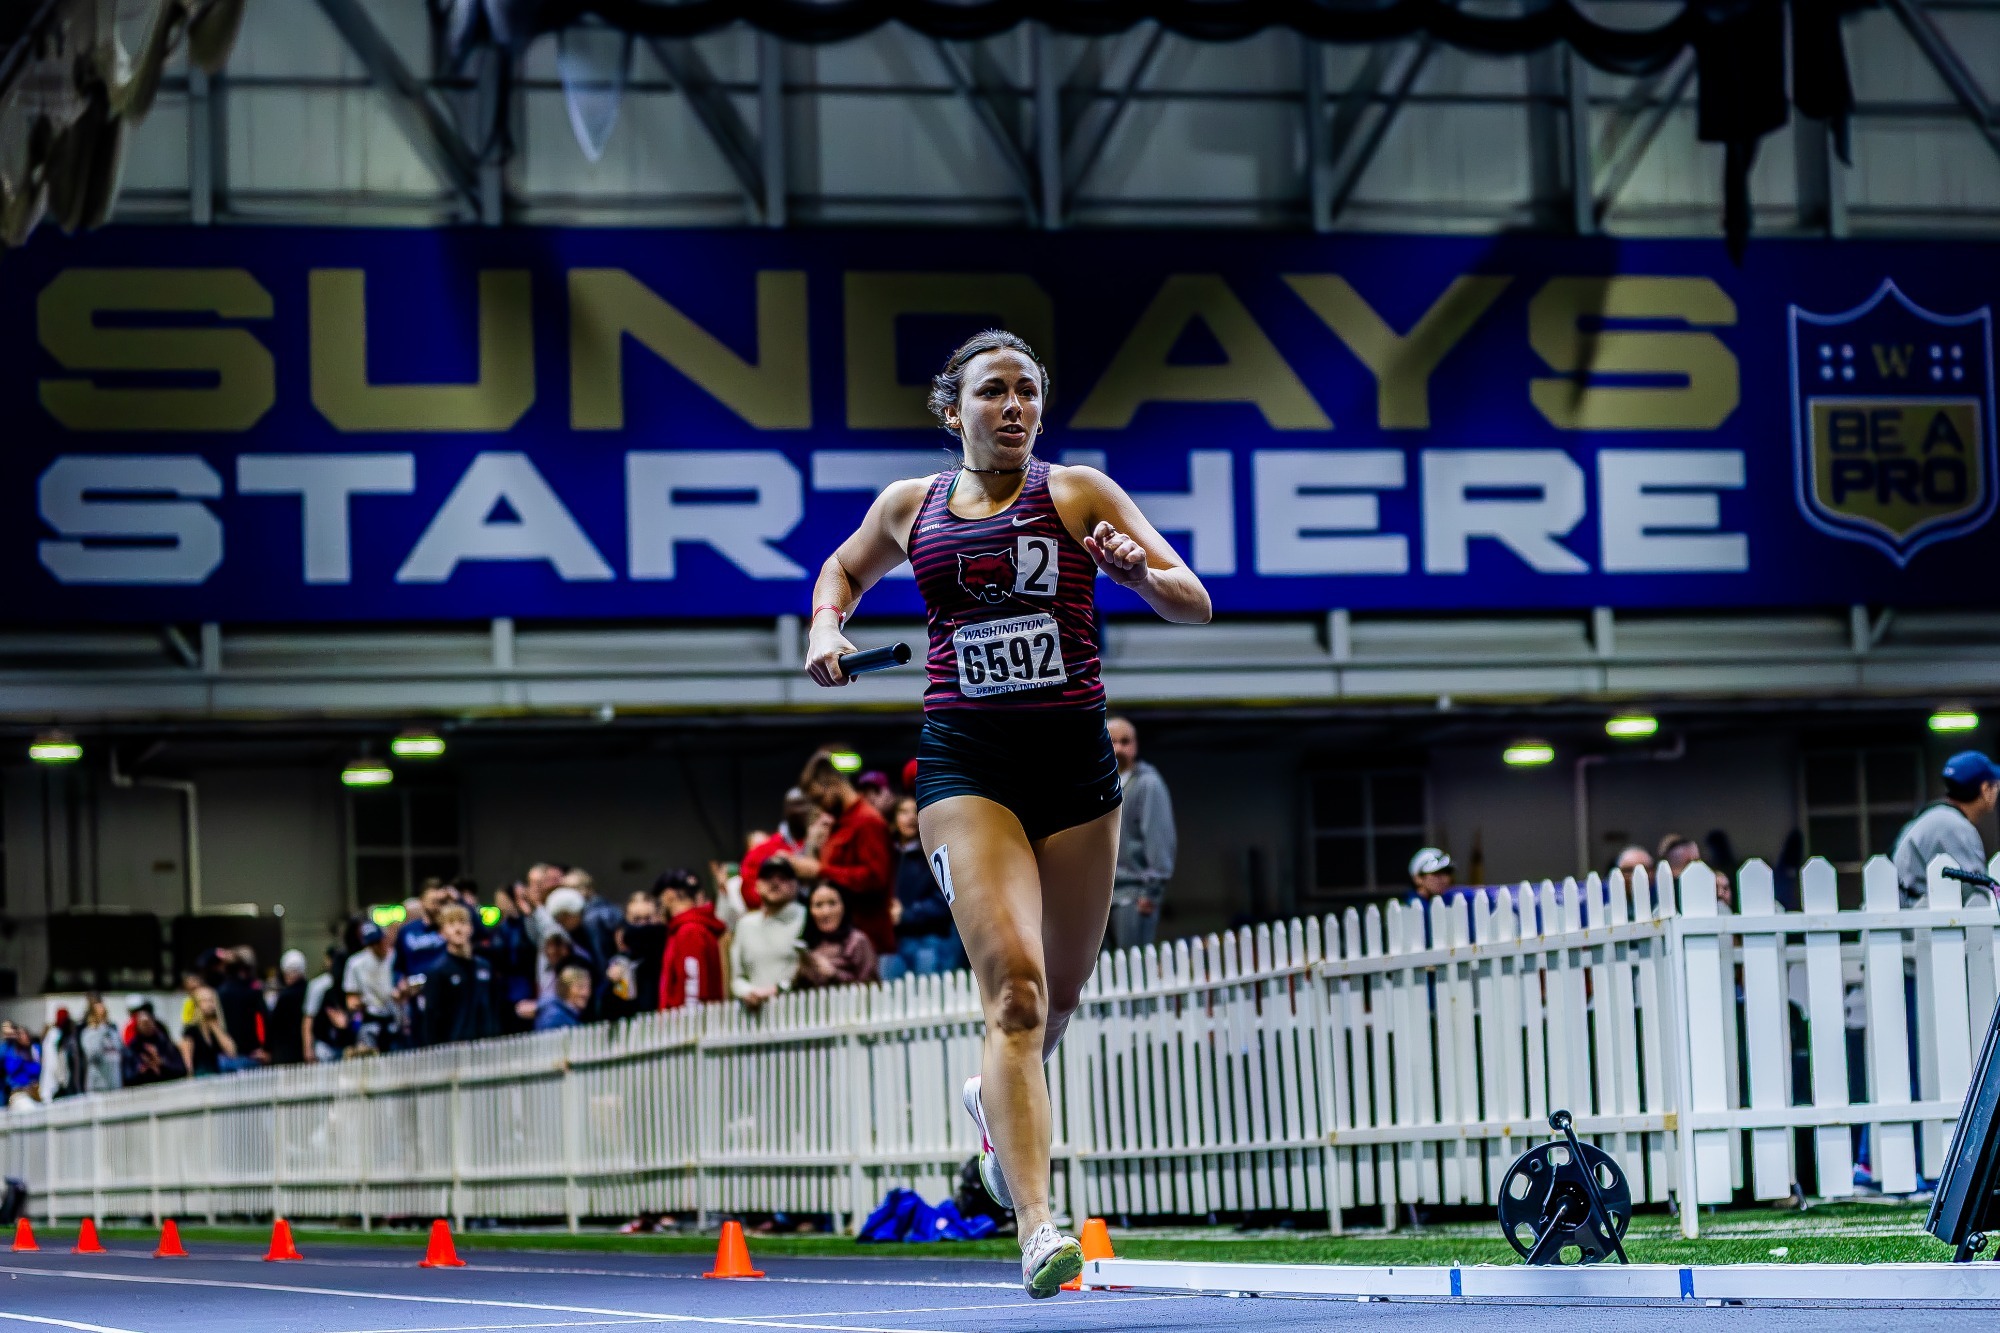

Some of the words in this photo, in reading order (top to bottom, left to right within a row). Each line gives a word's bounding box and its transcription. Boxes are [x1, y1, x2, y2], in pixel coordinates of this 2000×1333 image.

[37, 267, 1740, 432] SUNDAYS
[1870, 343, 1916, 379] W
[1829, 410, 1904, 454] BE
[1923, 411, 1965, 454] A
[1832, 457, 1968, 506] PRO
[1058, 449, 1750, 576] HERE
[1024, 540, 1050, 592] 2
[963, 618, 1045, 641] WASHINGTON
[963, 632, 1061, 685] 6592
[976, 684, 1017, 695] DEMPSEY
